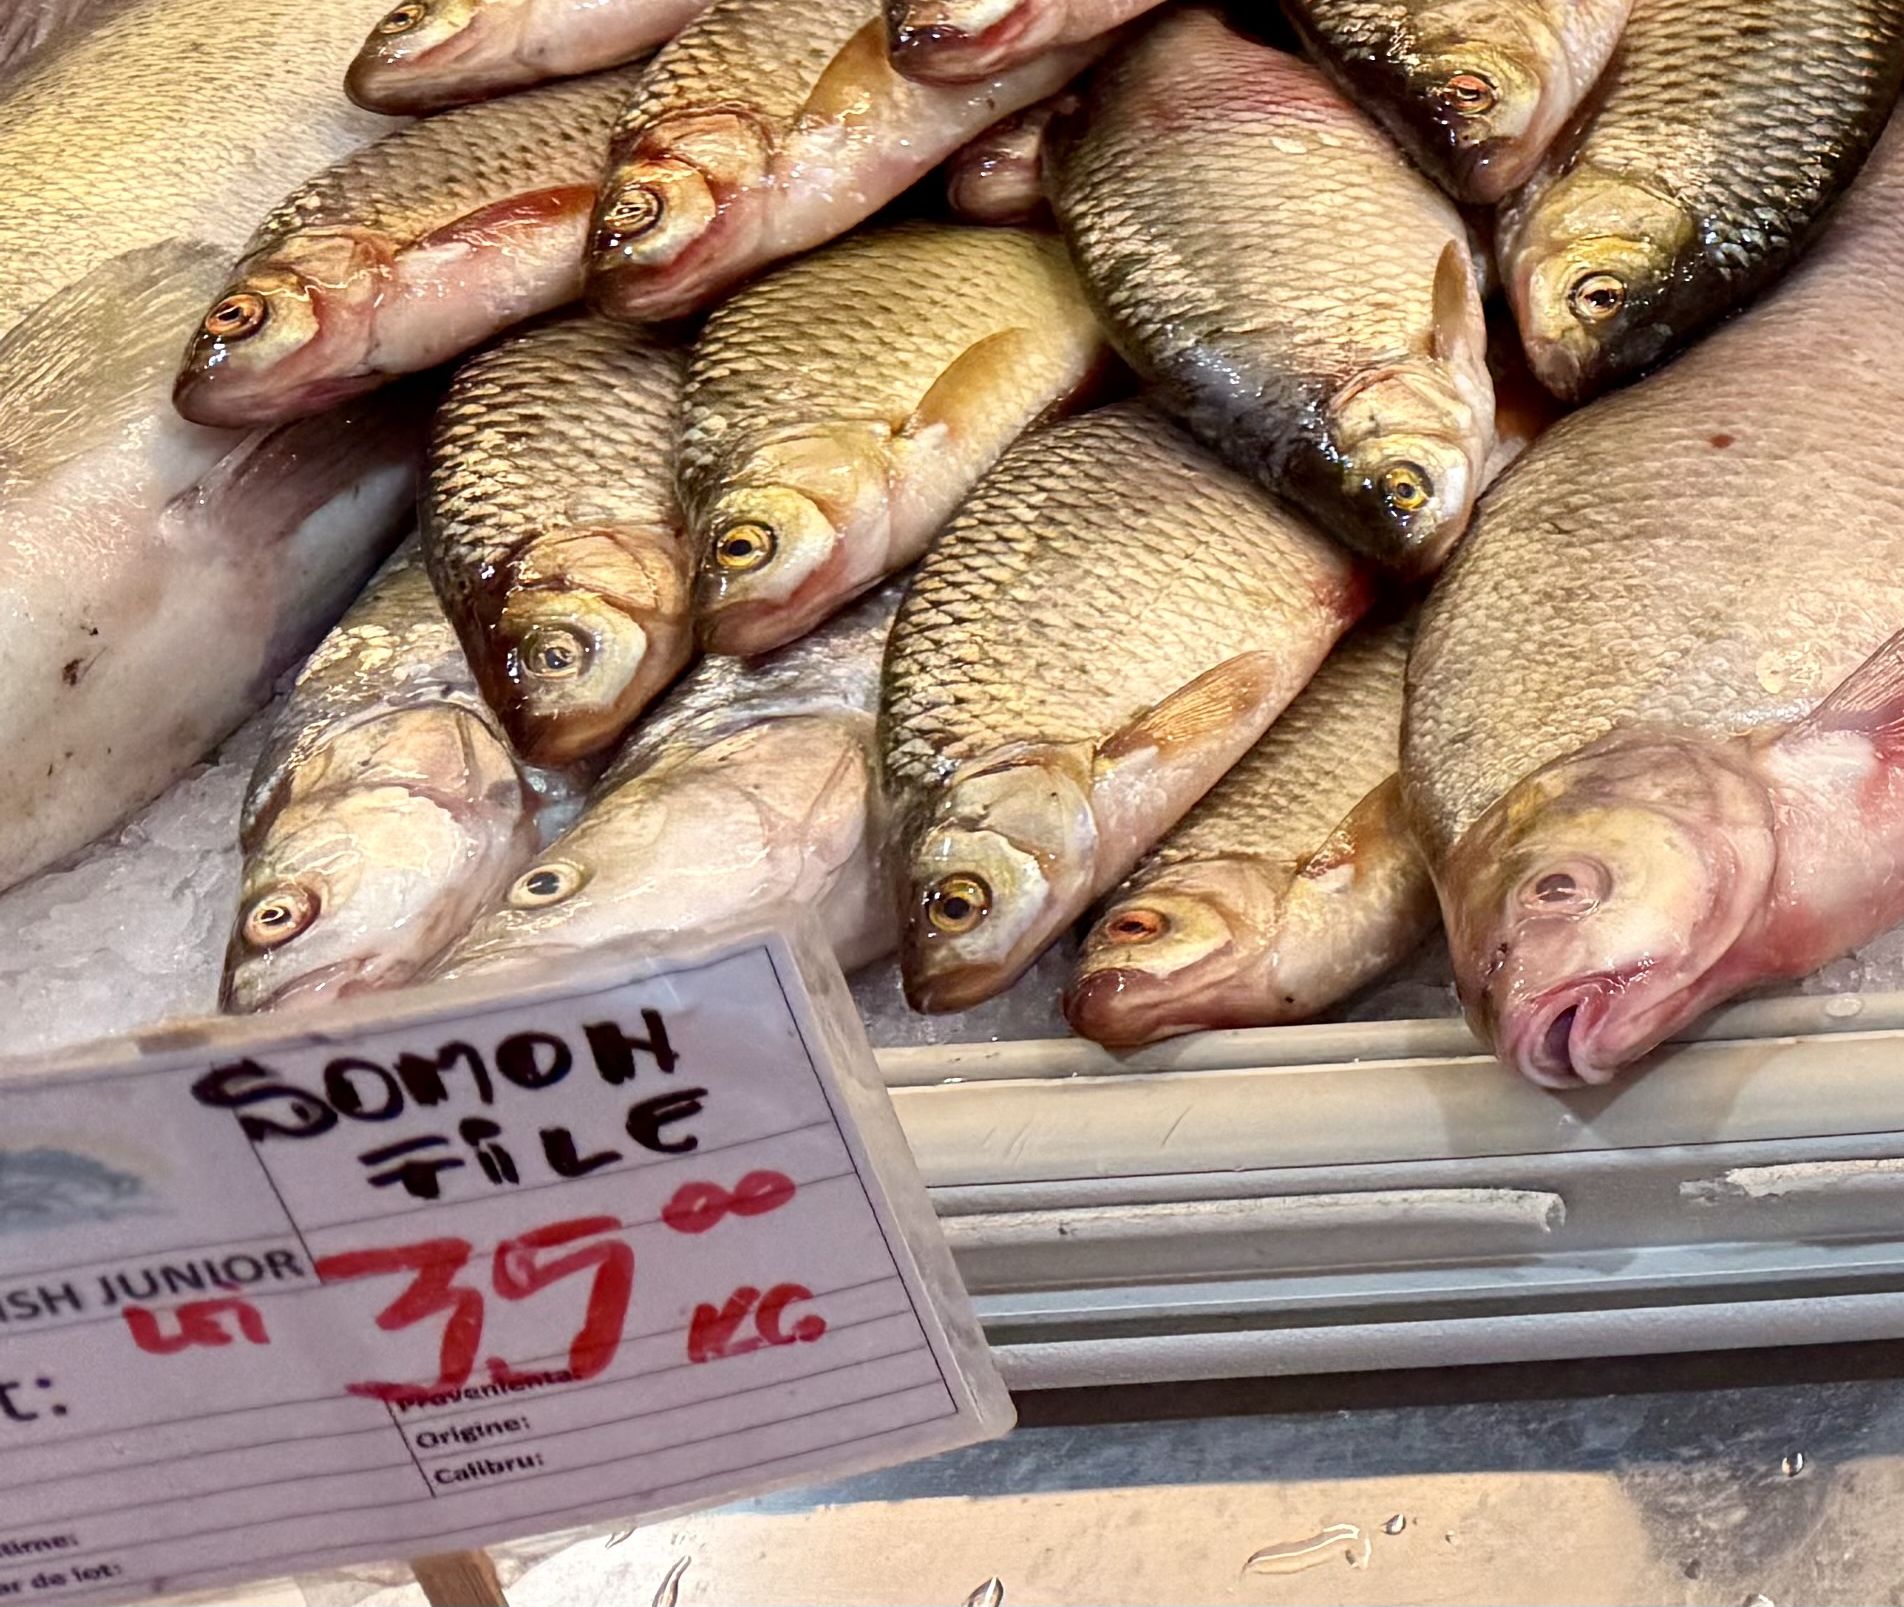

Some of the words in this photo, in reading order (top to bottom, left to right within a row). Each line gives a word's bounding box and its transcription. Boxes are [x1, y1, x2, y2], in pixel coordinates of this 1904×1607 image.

[99, 1249, 305, 1305] JUNIOR
[688, 1283, 826, 1363] KG
[416, 1415, 530, 1449] Origine:
[434, 1451, 543, 1485] Calibru:
